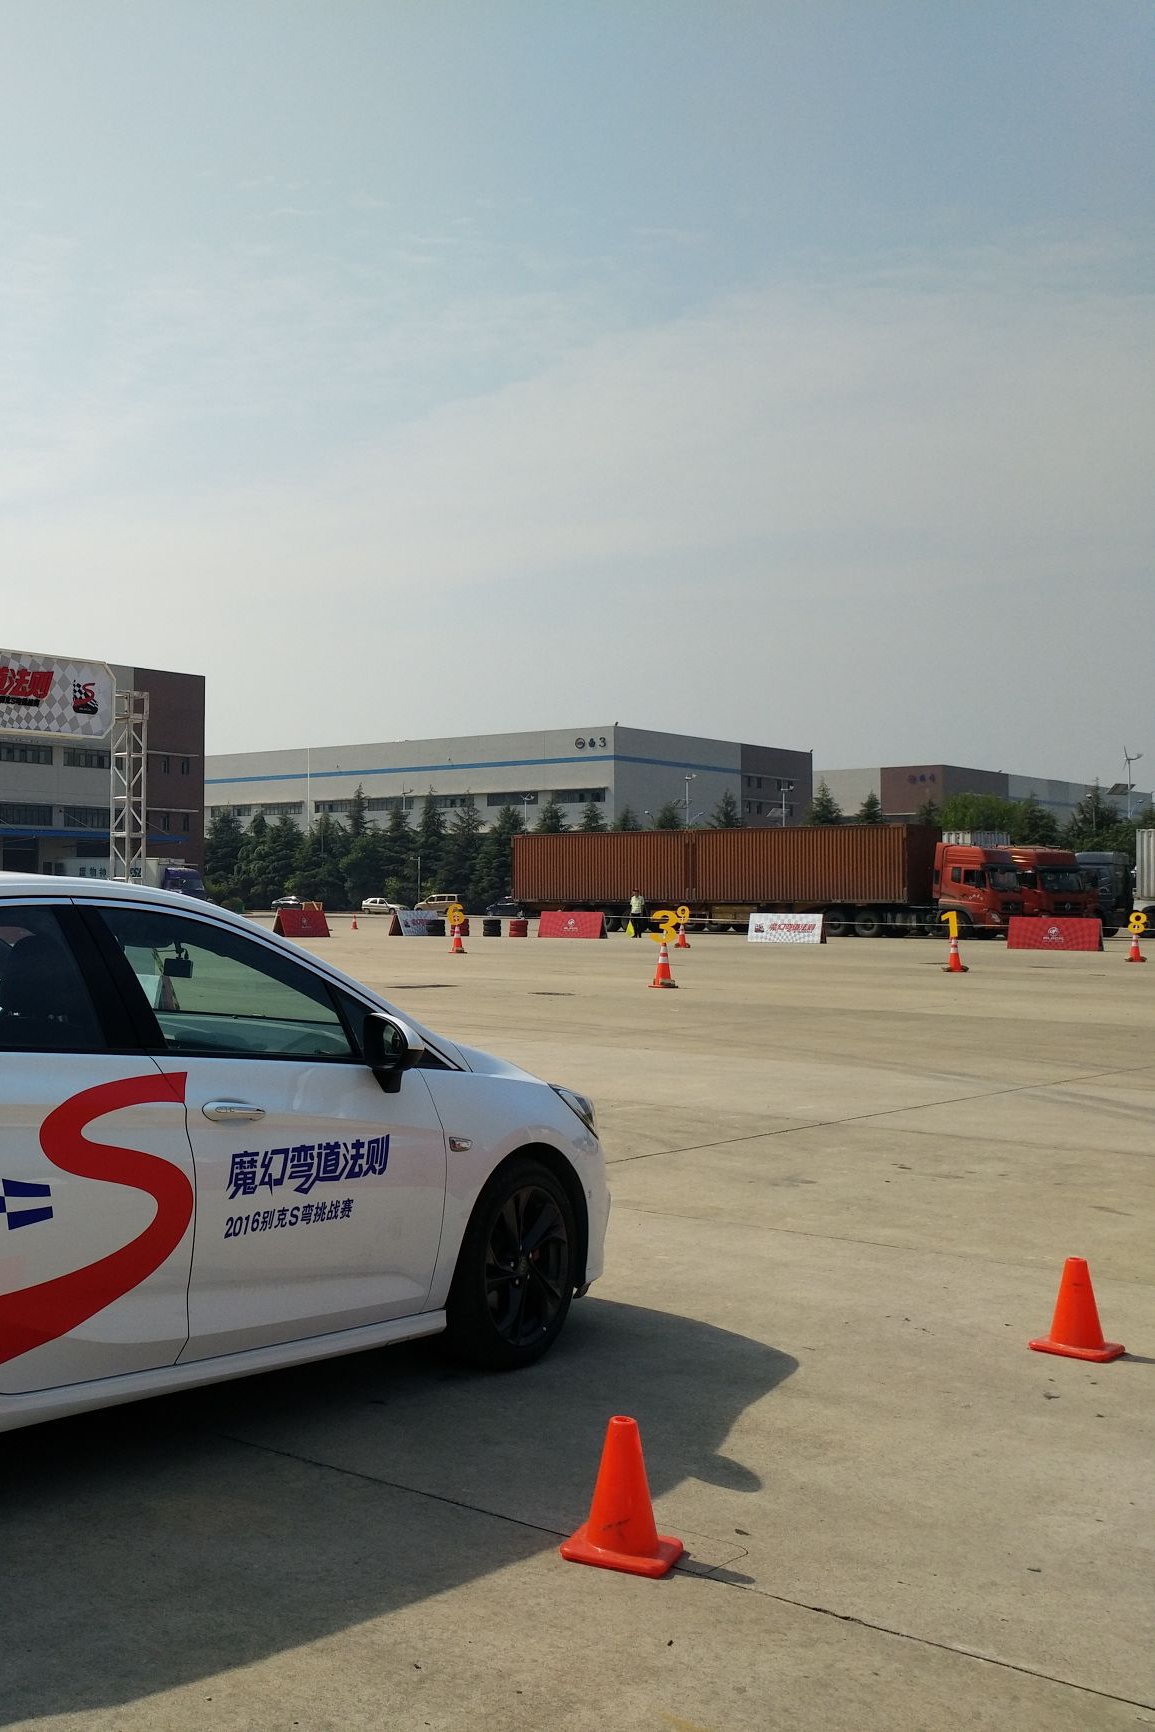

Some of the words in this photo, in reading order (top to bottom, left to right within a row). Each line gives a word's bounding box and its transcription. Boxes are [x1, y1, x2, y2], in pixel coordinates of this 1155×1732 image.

[447, 903, 465, 925] 6
[650, 909, 679, 944] 3
[676, 905, 690, 924] 9
[941, 910, 958, 938] 1
[1127, 911, 1147, 934] 8
[226, 1134, 391, 1200] 魔幻弯道法则
[224, 1198, 354, 1239] 2016别克S弯挑战赛
